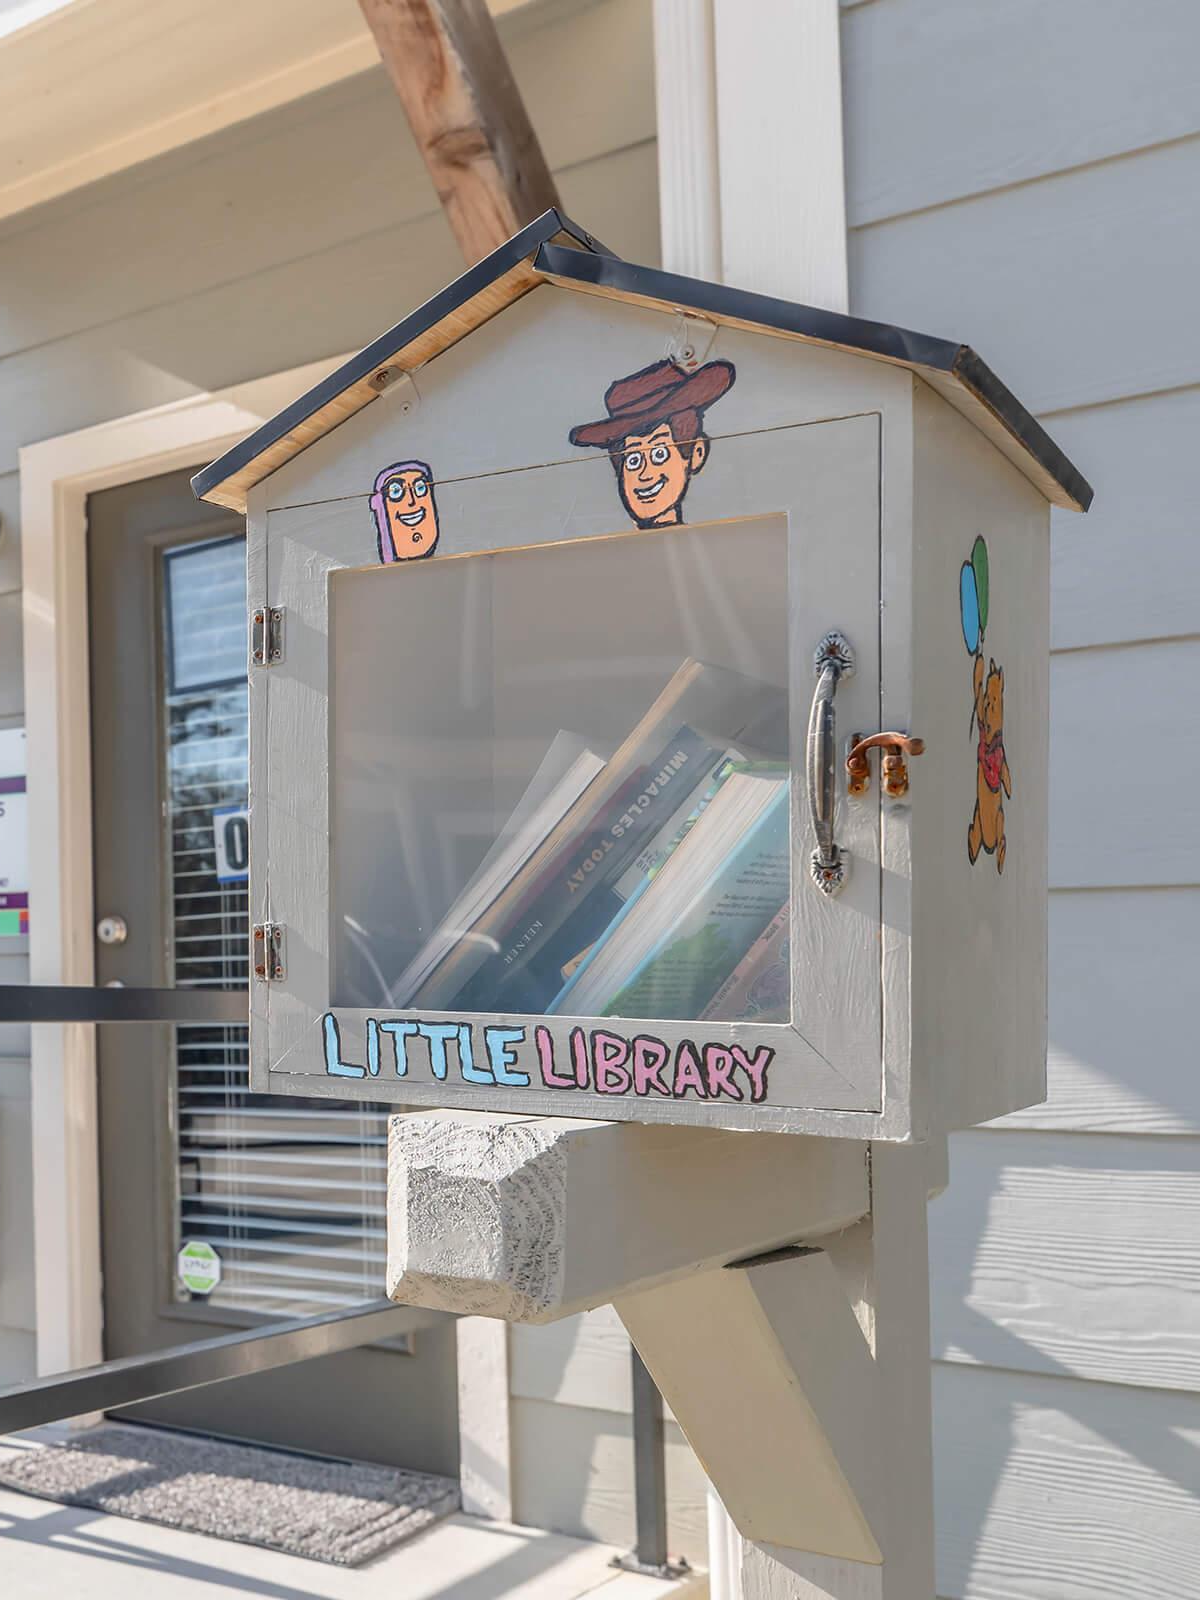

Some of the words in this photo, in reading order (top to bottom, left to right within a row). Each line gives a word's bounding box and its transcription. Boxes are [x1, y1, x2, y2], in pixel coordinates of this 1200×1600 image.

[611, 750, 688, 839] MIRACLES
[566, 838, 614, 894] TODAY
[503, 920, 543, 965] KEENER
[321, 1012, 530, 1088] LITTLE
[535, 1025, 776, 1103] LIBRARY
